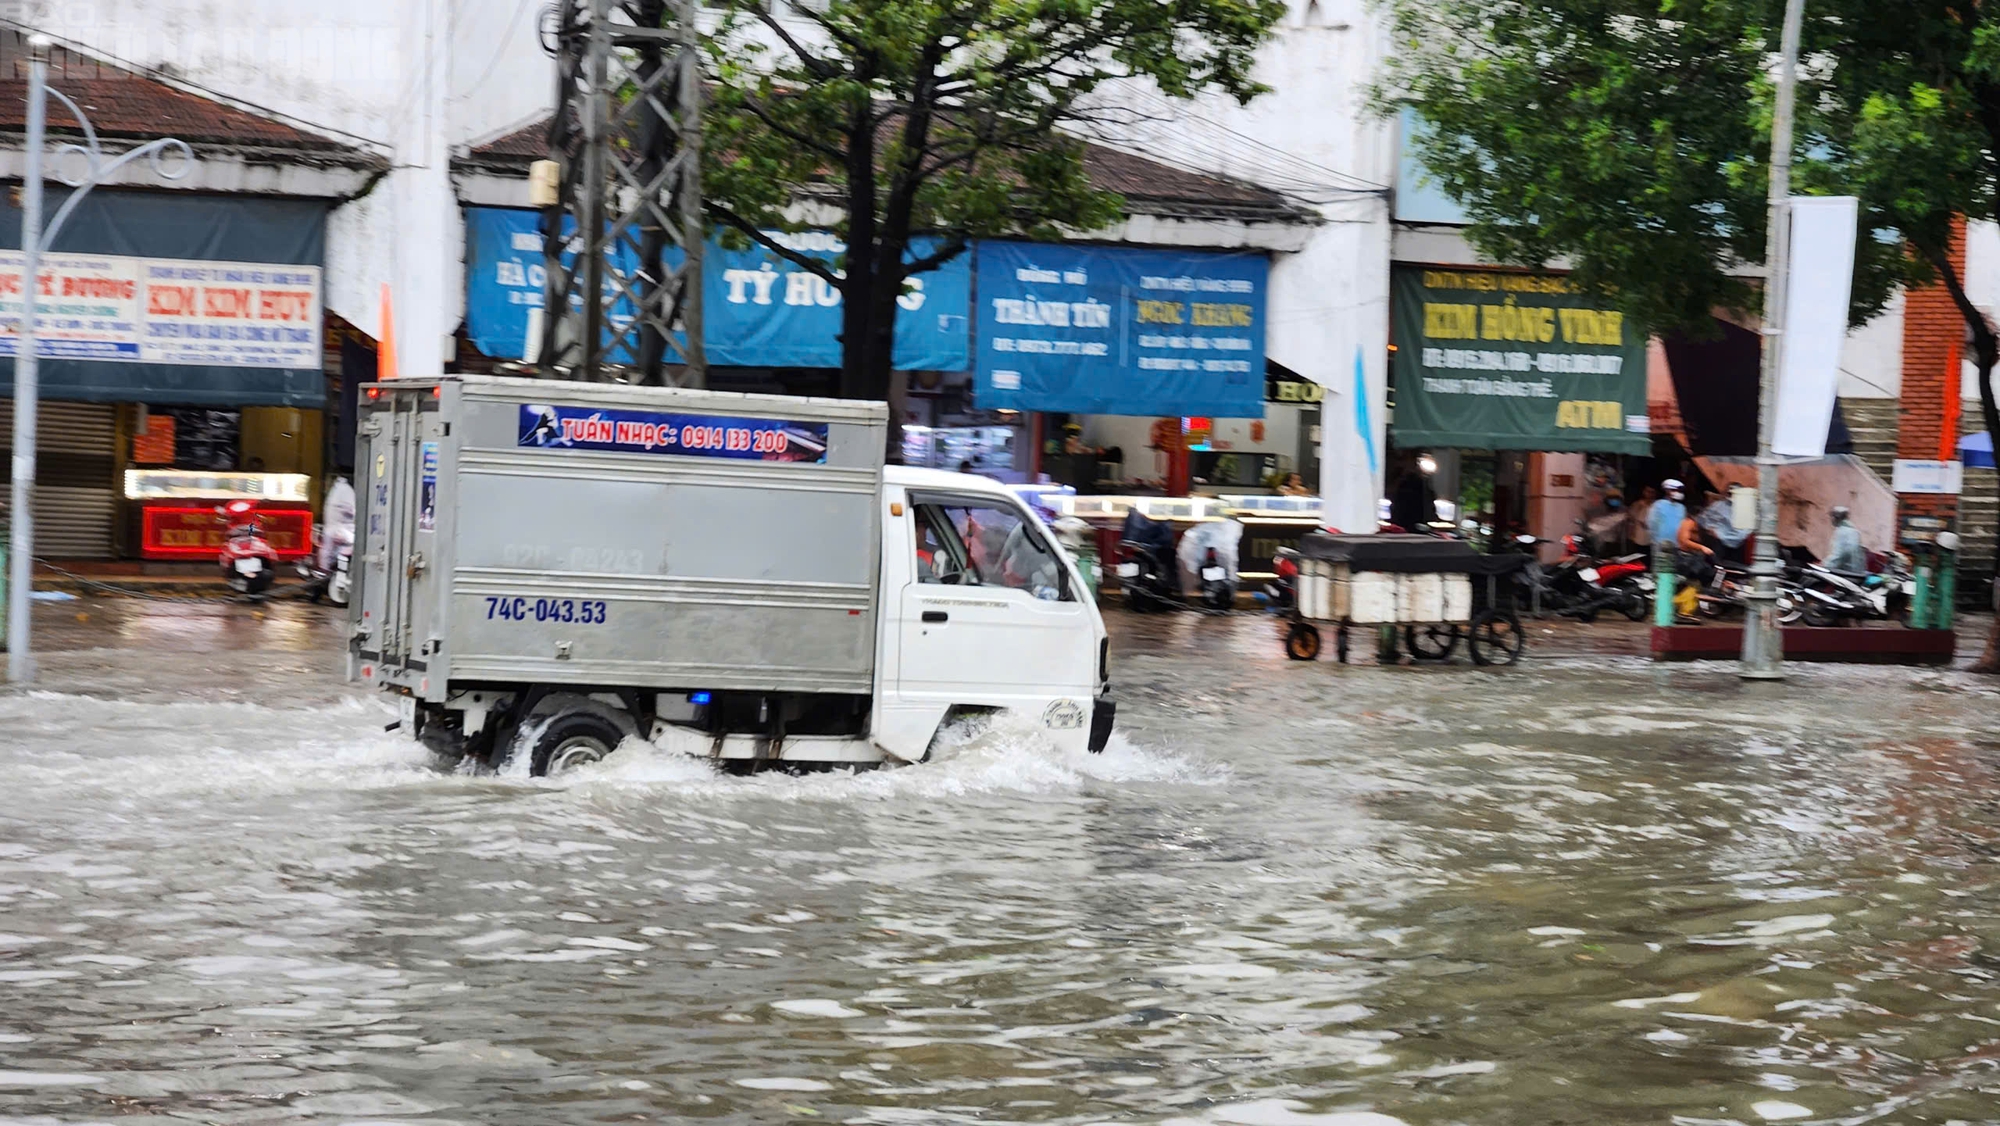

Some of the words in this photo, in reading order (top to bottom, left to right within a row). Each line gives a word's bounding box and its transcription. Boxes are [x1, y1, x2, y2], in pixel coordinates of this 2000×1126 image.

[147, 285, 196, 317] KIM
[203, 287, 252, 319] KIM
[259, 290, 313, 322] HUY
[1423, 301, 1478, 340] KIM
[1480, 293, 1556, 343] HỒNG
[561, 413, 613, 443] TUẤN
[615, 420, 677, 451] NHẠC:
[681, 426, 722, 448] 0914
[726, 429, 750, 452] 133
[753, 430, 788, 453] 200
[1555, 400, 1623, 430] ATM
[485, 597, 607, 624] 74C-043.53
